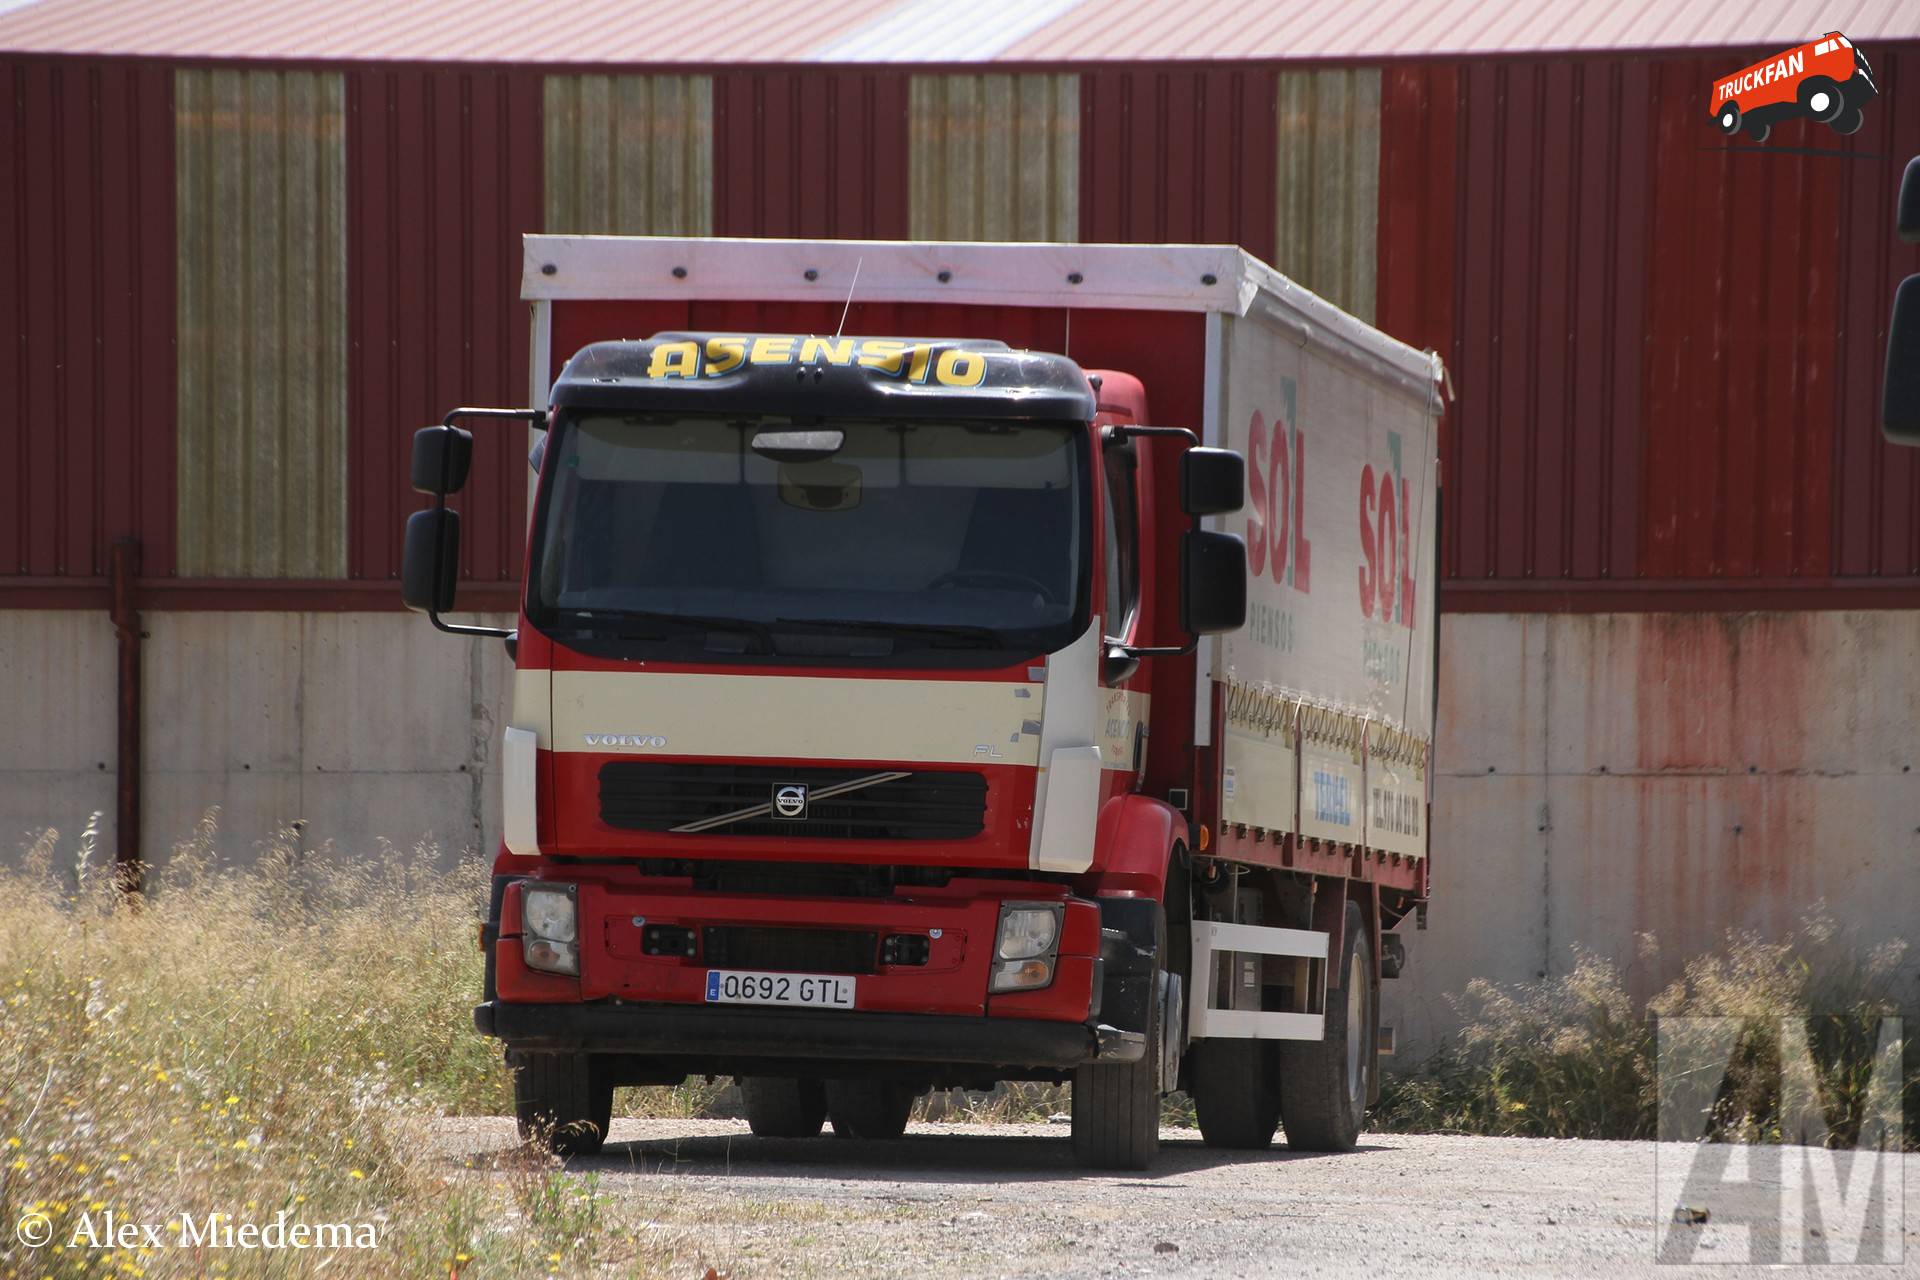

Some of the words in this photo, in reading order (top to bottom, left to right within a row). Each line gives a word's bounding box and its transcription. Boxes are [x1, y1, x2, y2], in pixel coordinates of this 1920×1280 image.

[647, 336, 988, 387] ASENSIO
[1249, 602, 1293, 653] PIENSOS
[583, 734, 667, 748] VOLVO
[974, 744, 1003, 757] FL
[710, 988, 716, 996] E
[724, 975, 790, 1001] 0692
[800, 979, 847, 1004] GTL
